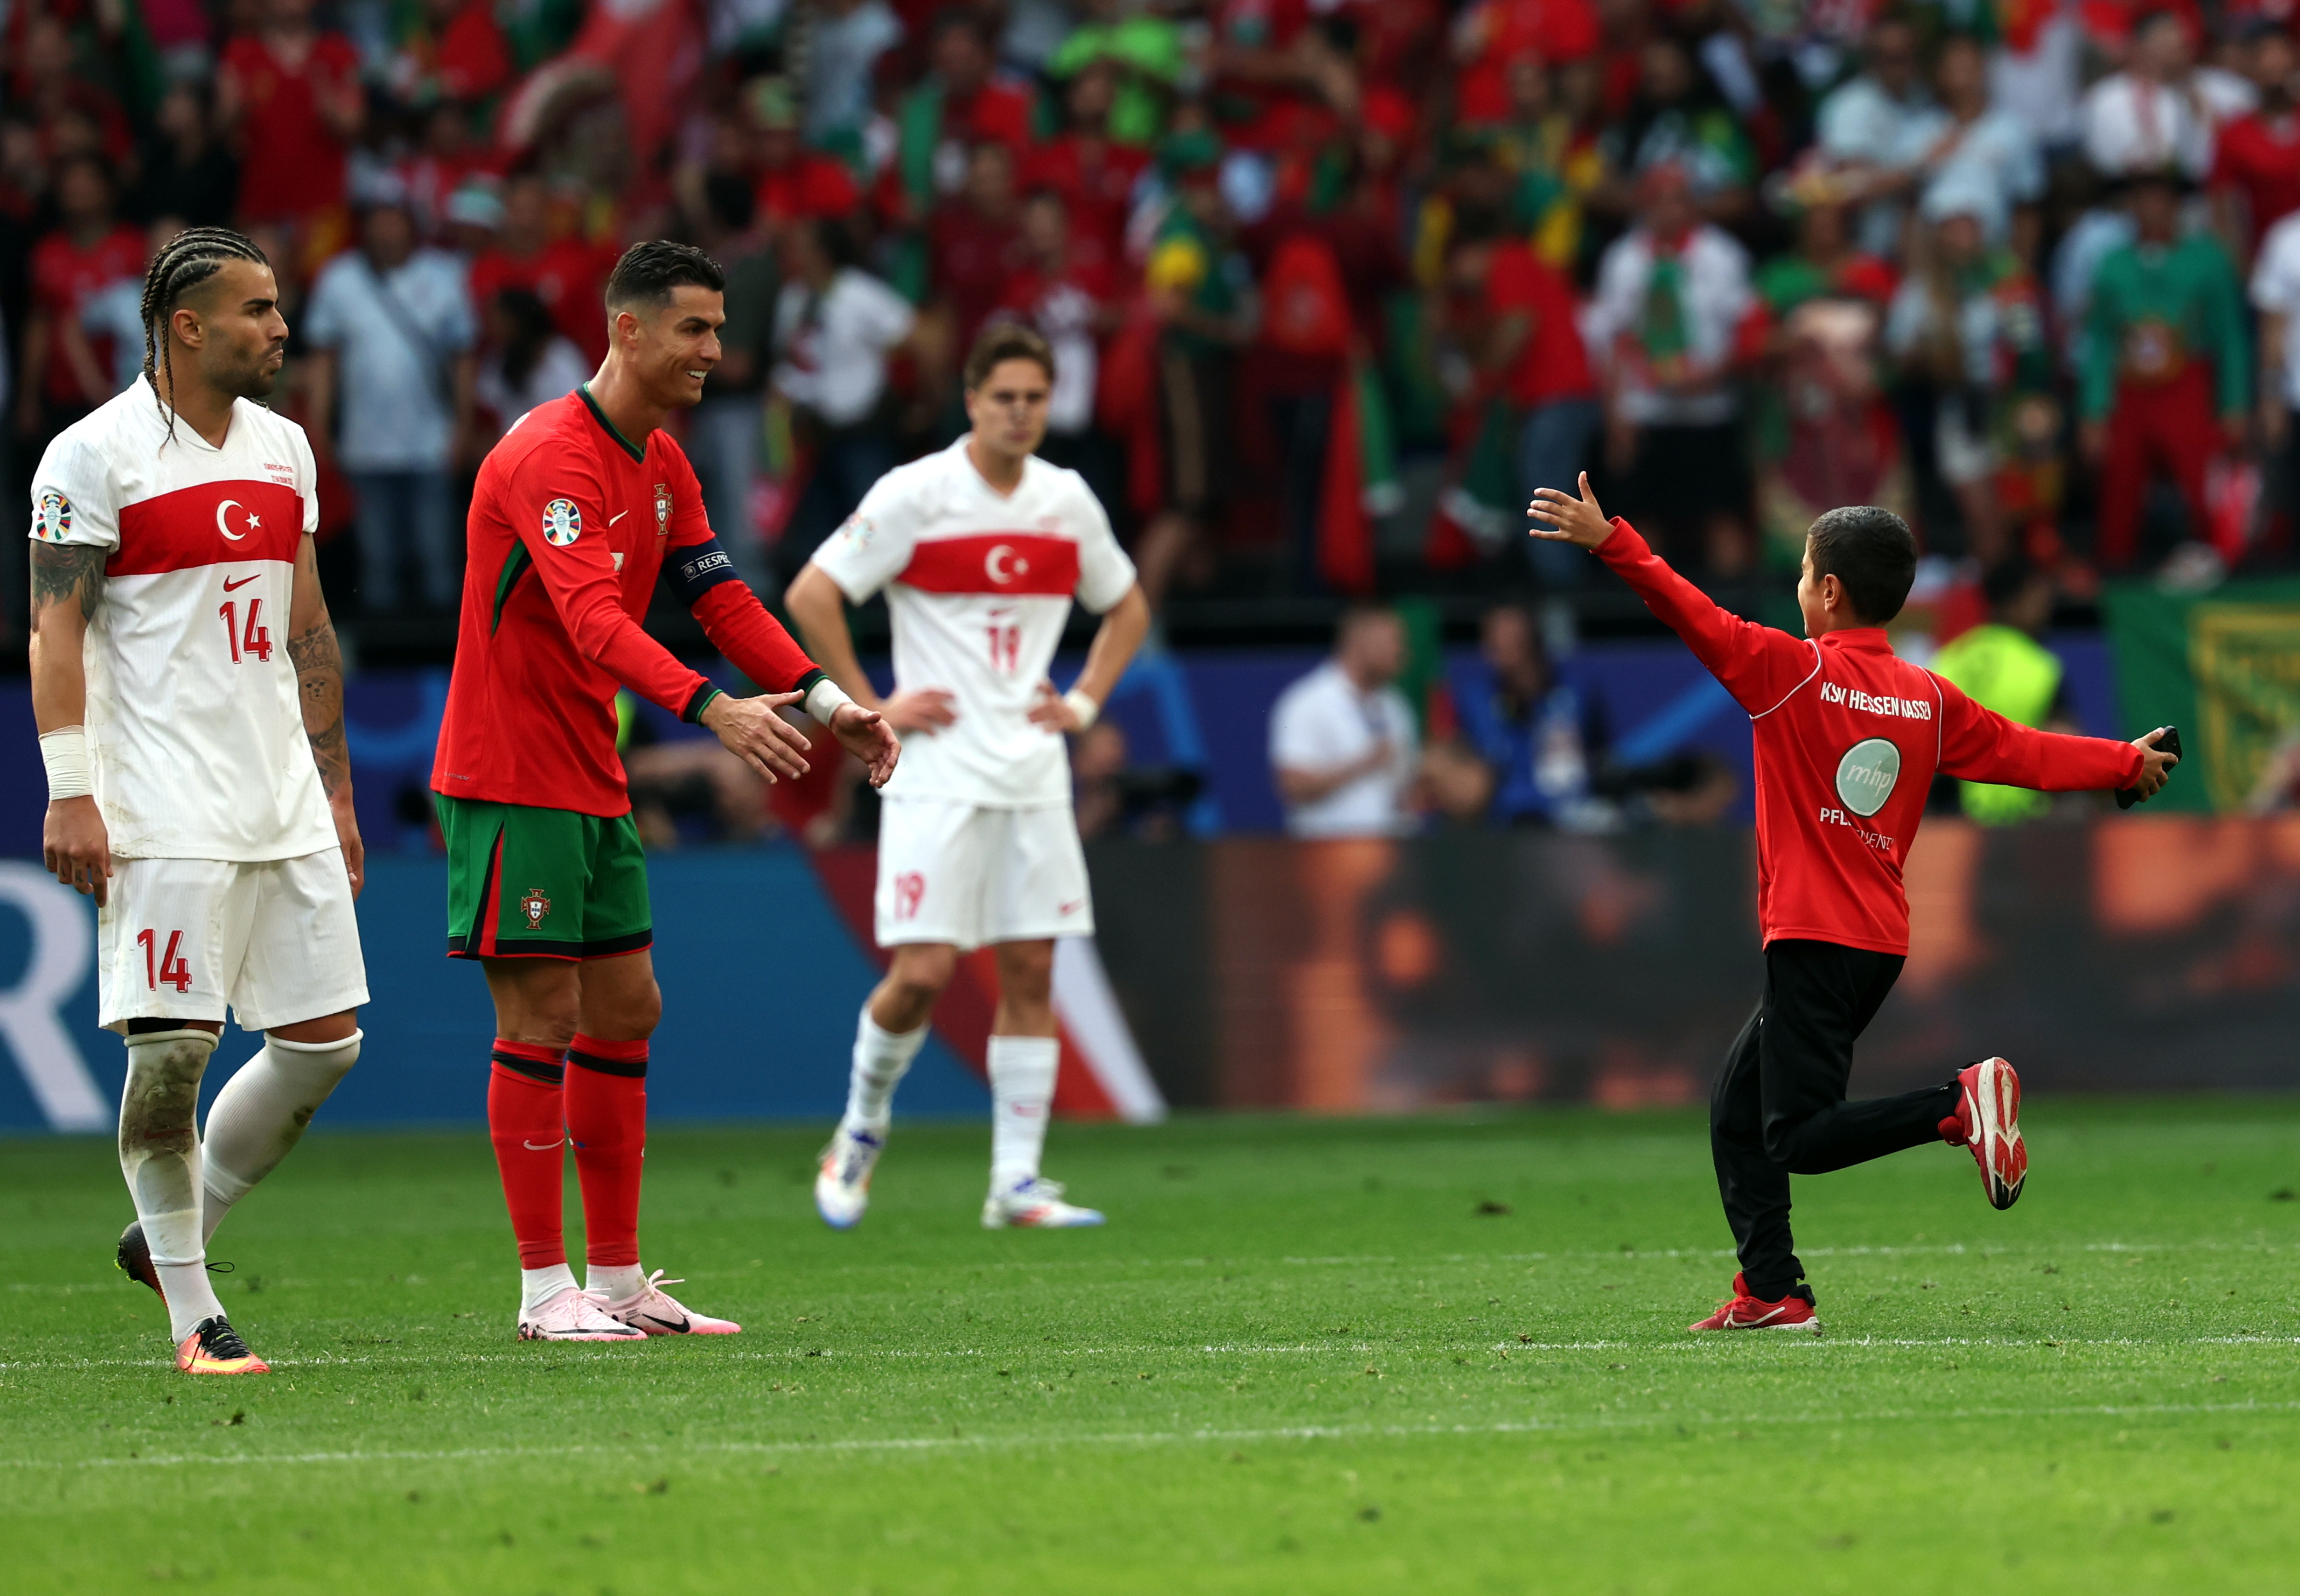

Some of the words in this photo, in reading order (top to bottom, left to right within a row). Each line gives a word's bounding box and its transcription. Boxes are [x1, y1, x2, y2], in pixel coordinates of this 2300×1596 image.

[219, 598, 273, 665] 14
[1820, 682, 1847, 706] KSV
[1849, 689, 1899, 716] HESSEN
[1846, 760, 1892, 797] mhp
[893, 870, 926, 921] 19
[137, 929, 192, 993] 14
